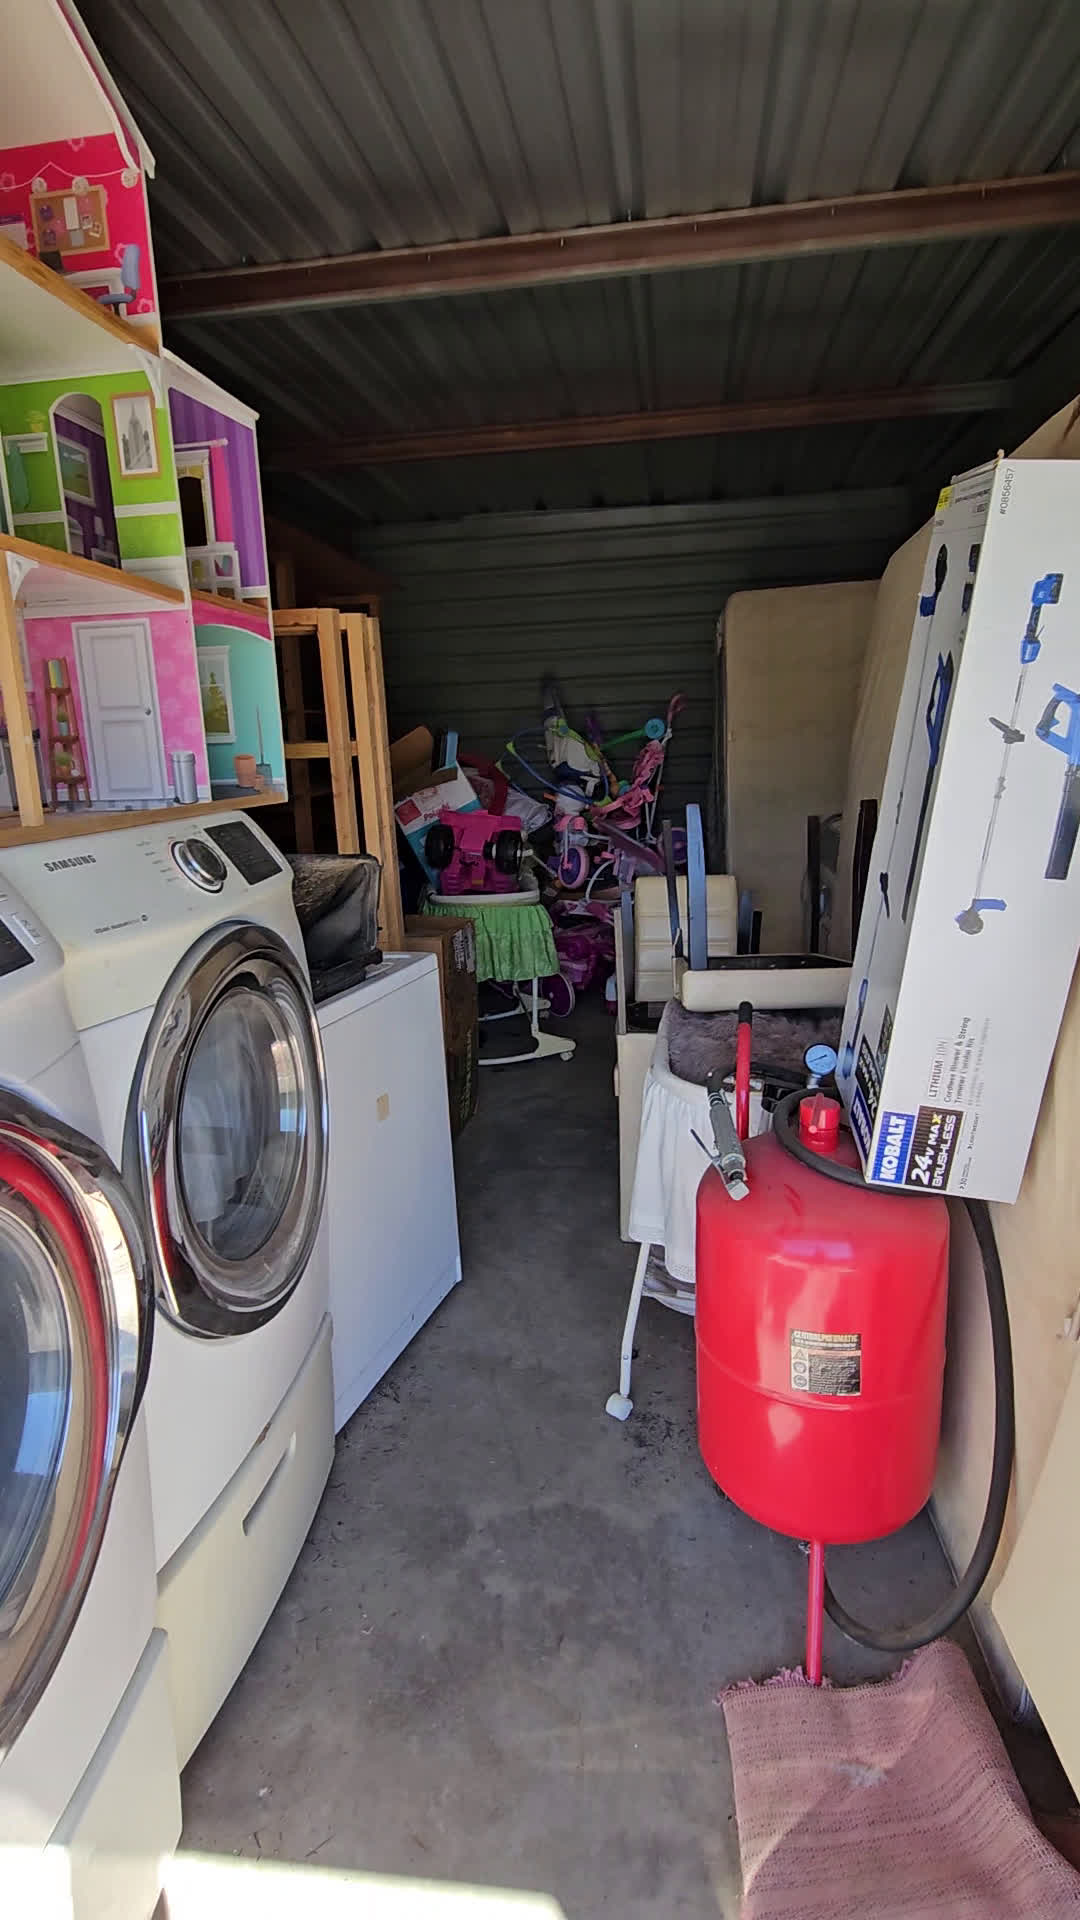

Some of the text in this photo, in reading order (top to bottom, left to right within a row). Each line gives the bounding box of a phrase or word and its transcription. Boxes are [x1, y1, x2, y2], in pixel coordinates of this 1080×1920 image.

[44, 854, 97, 873] SAMSUNG
[957, 1017, 971, 1039] String
[928, 1060, 945, 1098] LITHIUM
[928, 1114, 942, 1145] MAX
[880, 1115, 907, 1180] KOBALT
[932, 1115, 957, 1187] BRUSHLESS
